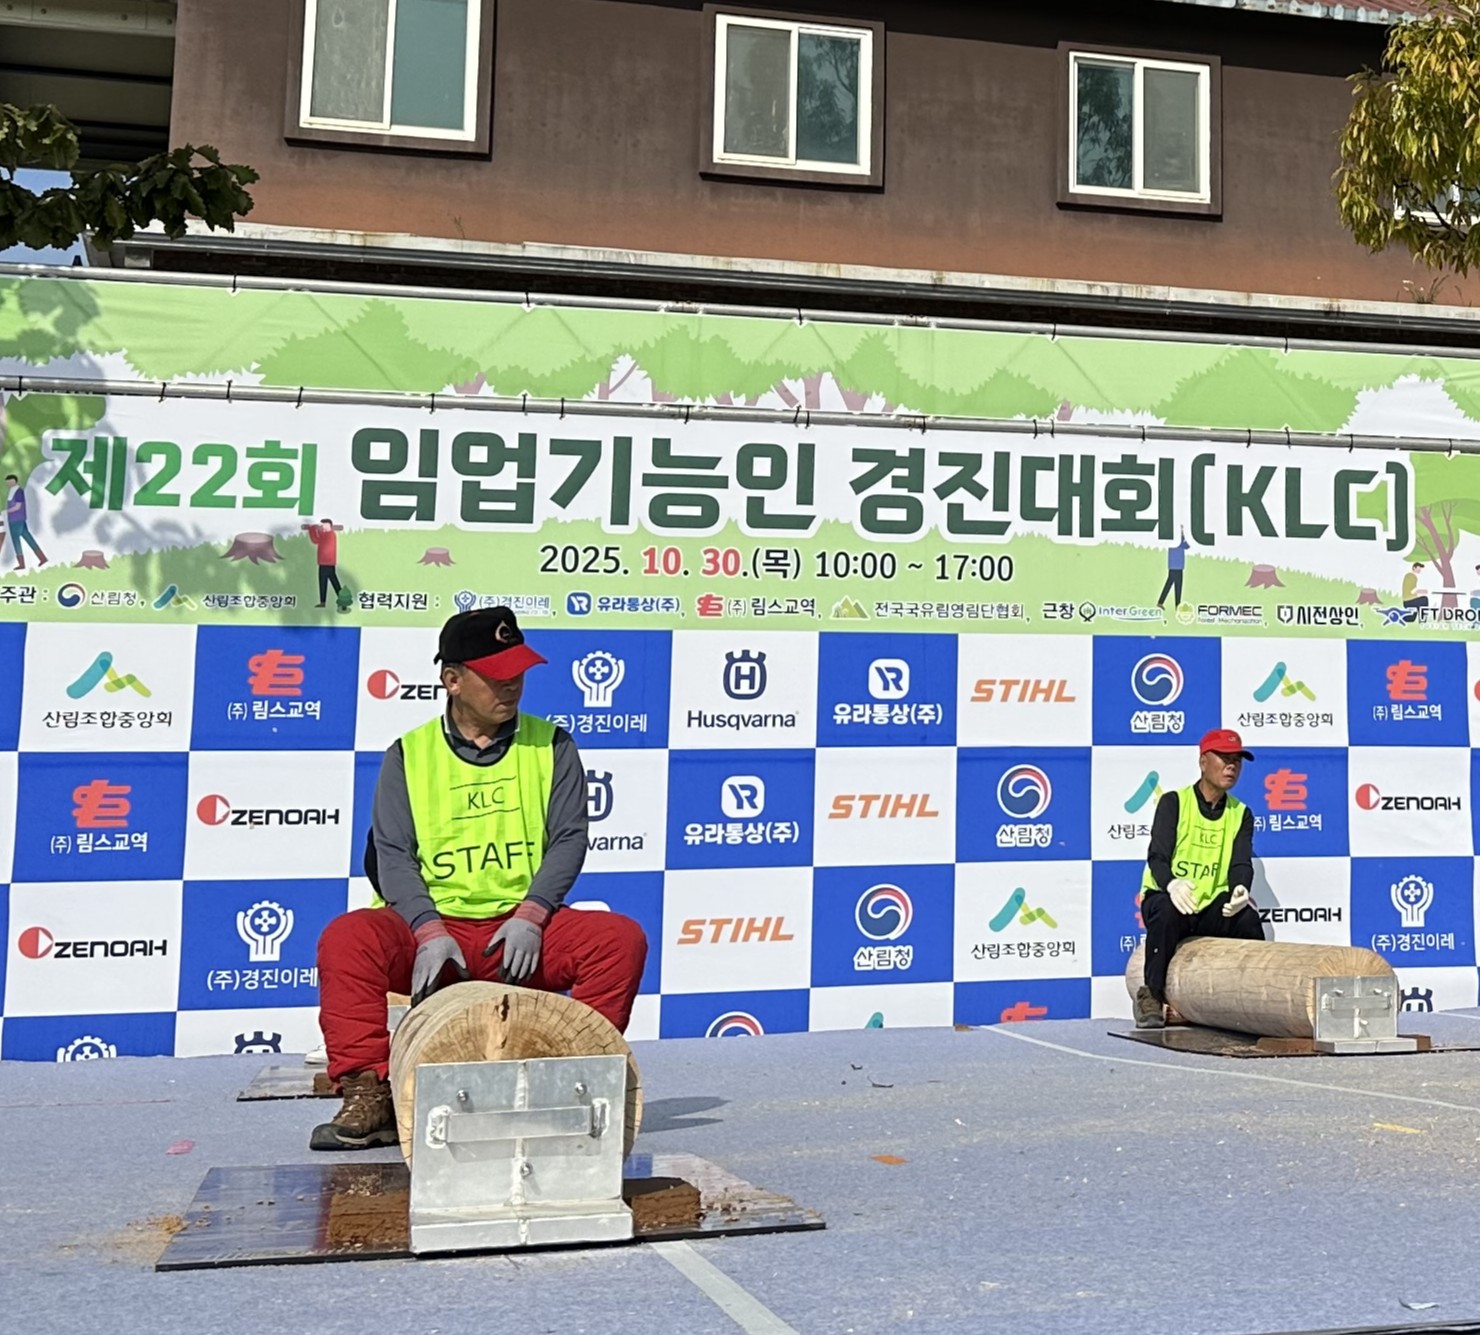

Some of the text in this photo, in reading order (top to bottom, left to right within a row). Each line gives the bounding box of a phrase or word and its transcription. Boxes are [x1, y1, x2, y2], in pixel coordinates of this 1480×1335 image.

[44, 427, 1410, 552] 제22회 임업기능인 경진대회(KLC)
[539, 545, 630, 575] 2025.
[642, 547, 690, 577] 10.
[701, 548, 801, 581] 30.(목)
[815, 552, 897, 580] 10:00
[935, 554, 1015, 582] 17:00
[0, 586, 37, 604] 주관
[90, 591, 146, 606] 산림청,
[202, 594, 297, 608] 산림조합중앙회
[358, 592, 428, 611] 협력지원
[1042, 603, 1075, 619] 근창
[1198, 605, 1262, 617] FORMEC
[400, 684, 449, 701] ZEN
[970, 678, 1076, 703] STIHL
[42, 710, 173, 729] 산림조합중앙회
[227, 700, 322, 720] (주) 림스교역
[687, 710, 796, 731] Husqvarna
[833, 703, 943, 725] 유라통상(주)
[1237, 712, 1334, 728] 산림조합중앙회
[1373, 704, 1442, 721] (주) 림스교역
[1131, 711, 1184, 732] 산림청
[467, 787, 505, 810] KLC
[828, 794, 939, 819] STIHL
[1381, 797, 1461, 811] ZENOAH
[231, 808, 340, 826] ZENOAH
[1268, 815, 1322, 831] 림스교역
[50, 832, 148, 854] (주) 림스교역
[684, 822, 799, 845] 유라통상(주)
[996, 825, 1052, 846] 산림청
[1199, 832, 1217, 845] KLC
[1174, 860, 1220, 880] STAF
[1258, 907, 1342, 923] ZENOAH
[677, 916, 794, 945] STIHL
[54, 939, 167, 959] ZENOAH
[970, 940, 1076, 960] 산림조합중앙회
[1371, 933, 1455, 952] (주)경진이레
[854, 947, 912, 969] 산림청
[206, 966, 318, 990] (주)경진이레
